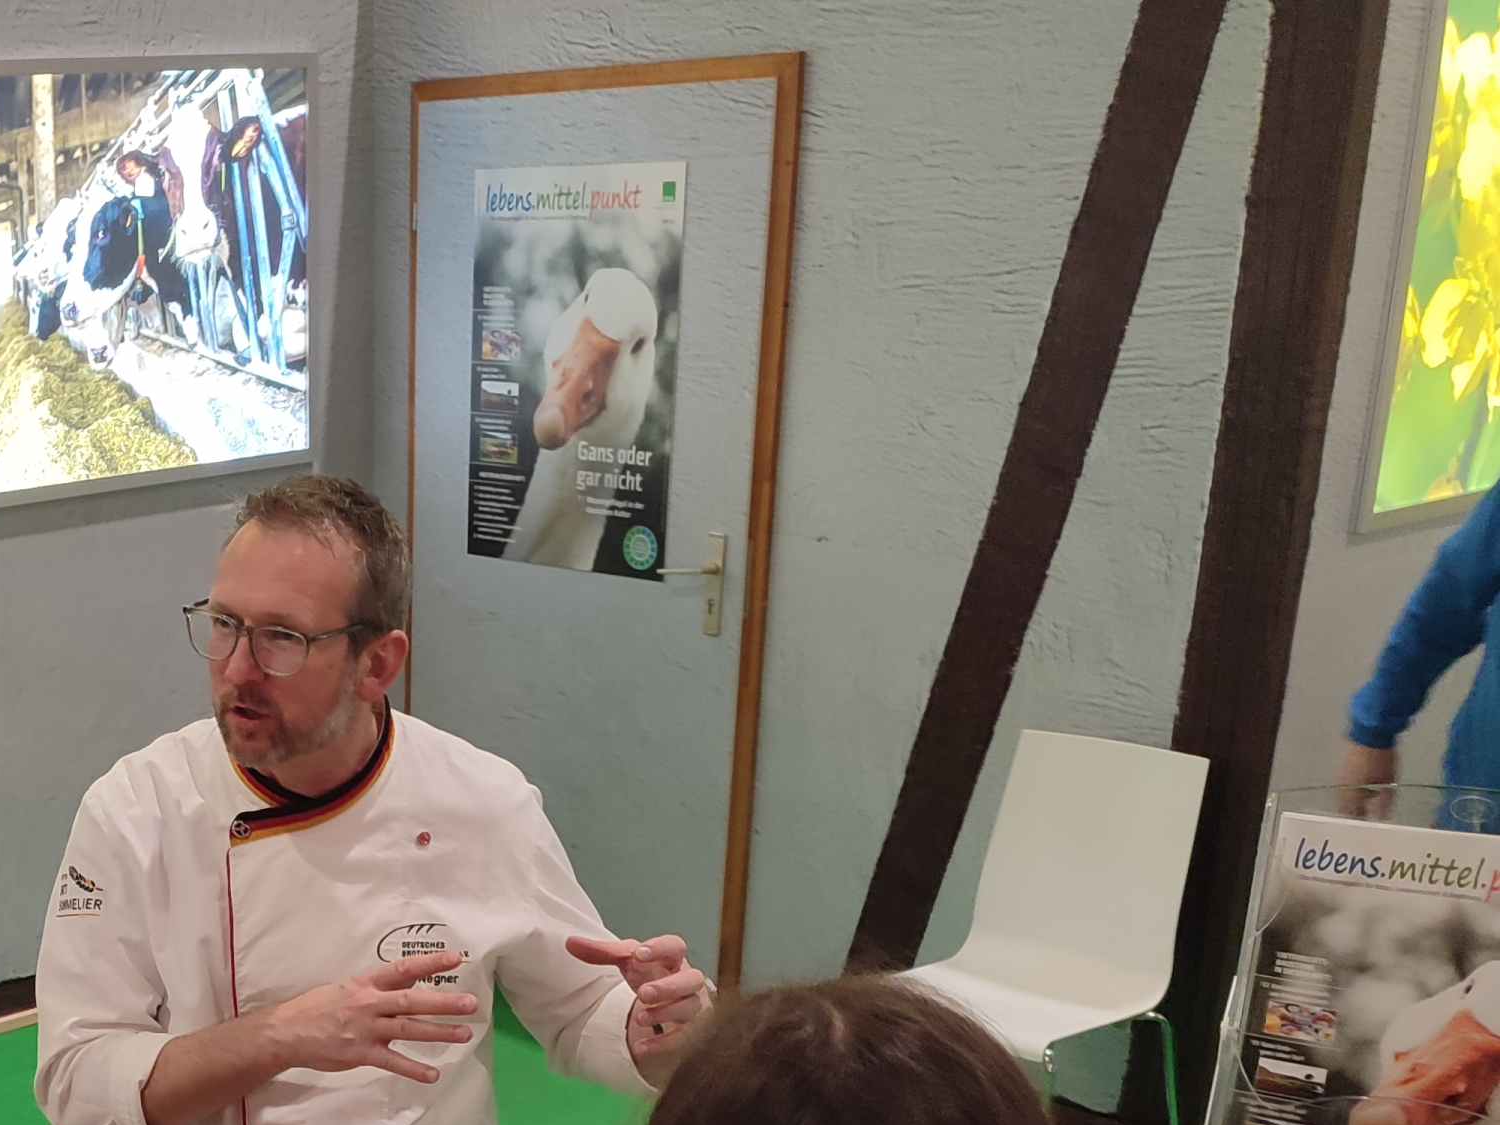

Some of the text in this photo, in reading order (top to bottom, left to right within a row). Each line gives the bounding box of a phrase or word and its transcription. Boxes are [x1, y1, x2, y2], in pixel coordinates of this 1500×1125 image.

[486, 180, 643, 224] lebens.mittel.punkt
[578, 441, 653, 466] Gans oder
[575, 468, 644, 492] gar nicht
[401, 941, 446, 950] DEUTSCHES
